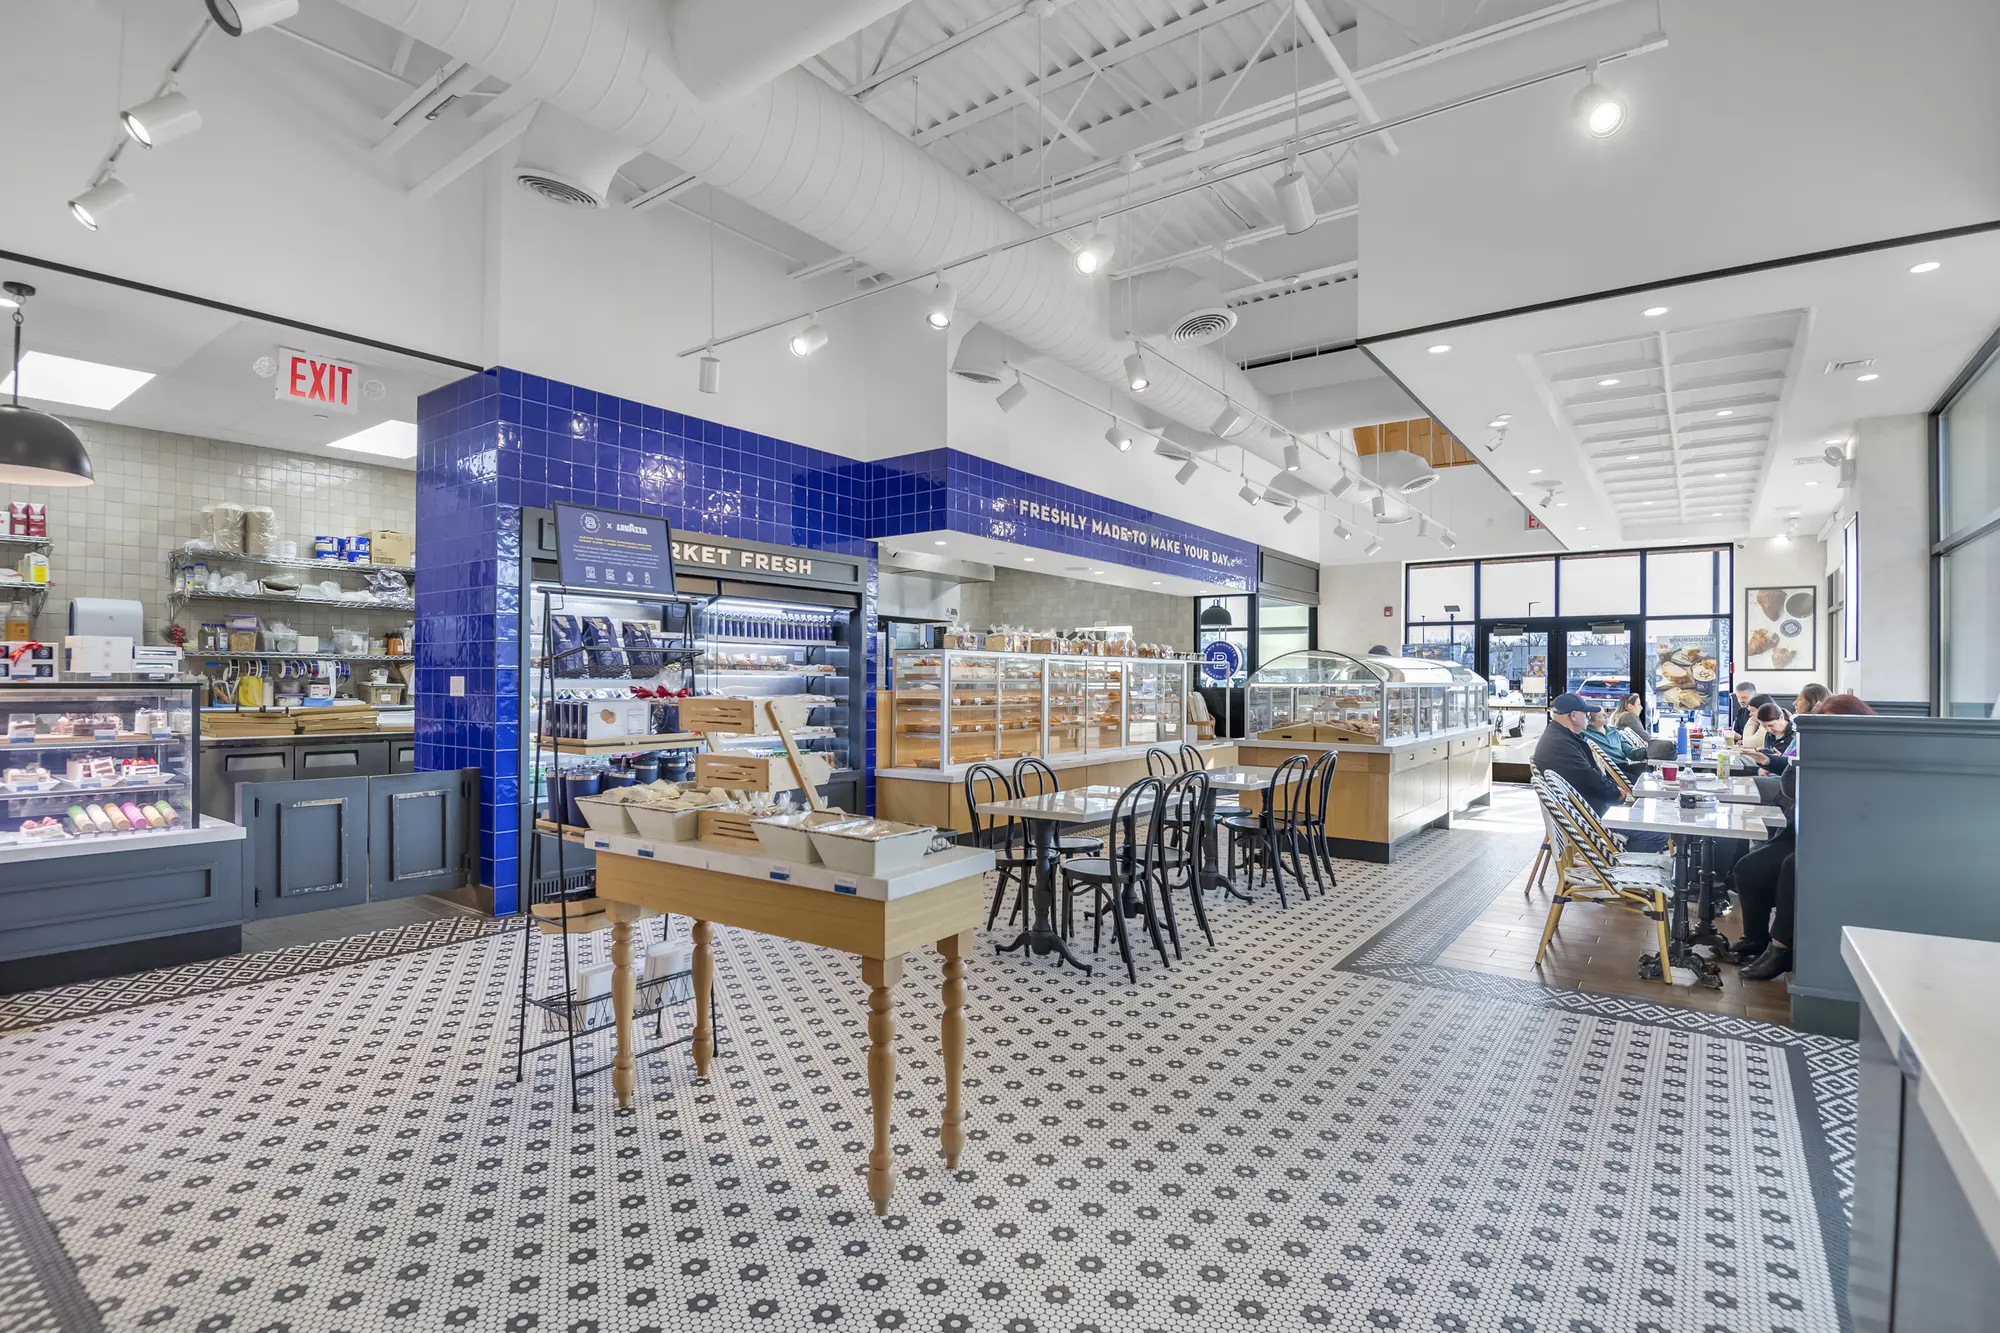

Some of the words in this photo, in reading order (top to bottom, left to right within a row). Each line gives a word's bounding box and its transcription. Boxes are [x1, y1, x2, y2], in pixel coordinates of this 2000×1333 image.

[290, 356, 353, 406] EXIT
[1019, 499, 1087, 530] FRESHLY
[1091, 518, 1129, 541] MADE
[1131, 529, 1147, 545] TO
[1150, 534, 1181, 554] MAKE
[1183, 543, 1209, 561] YOUR
[671, 542, 731, 566] RKET
[740, 551, 812, 575] FRESH
[1216, 643, 1237, 657] BAGUETTE
